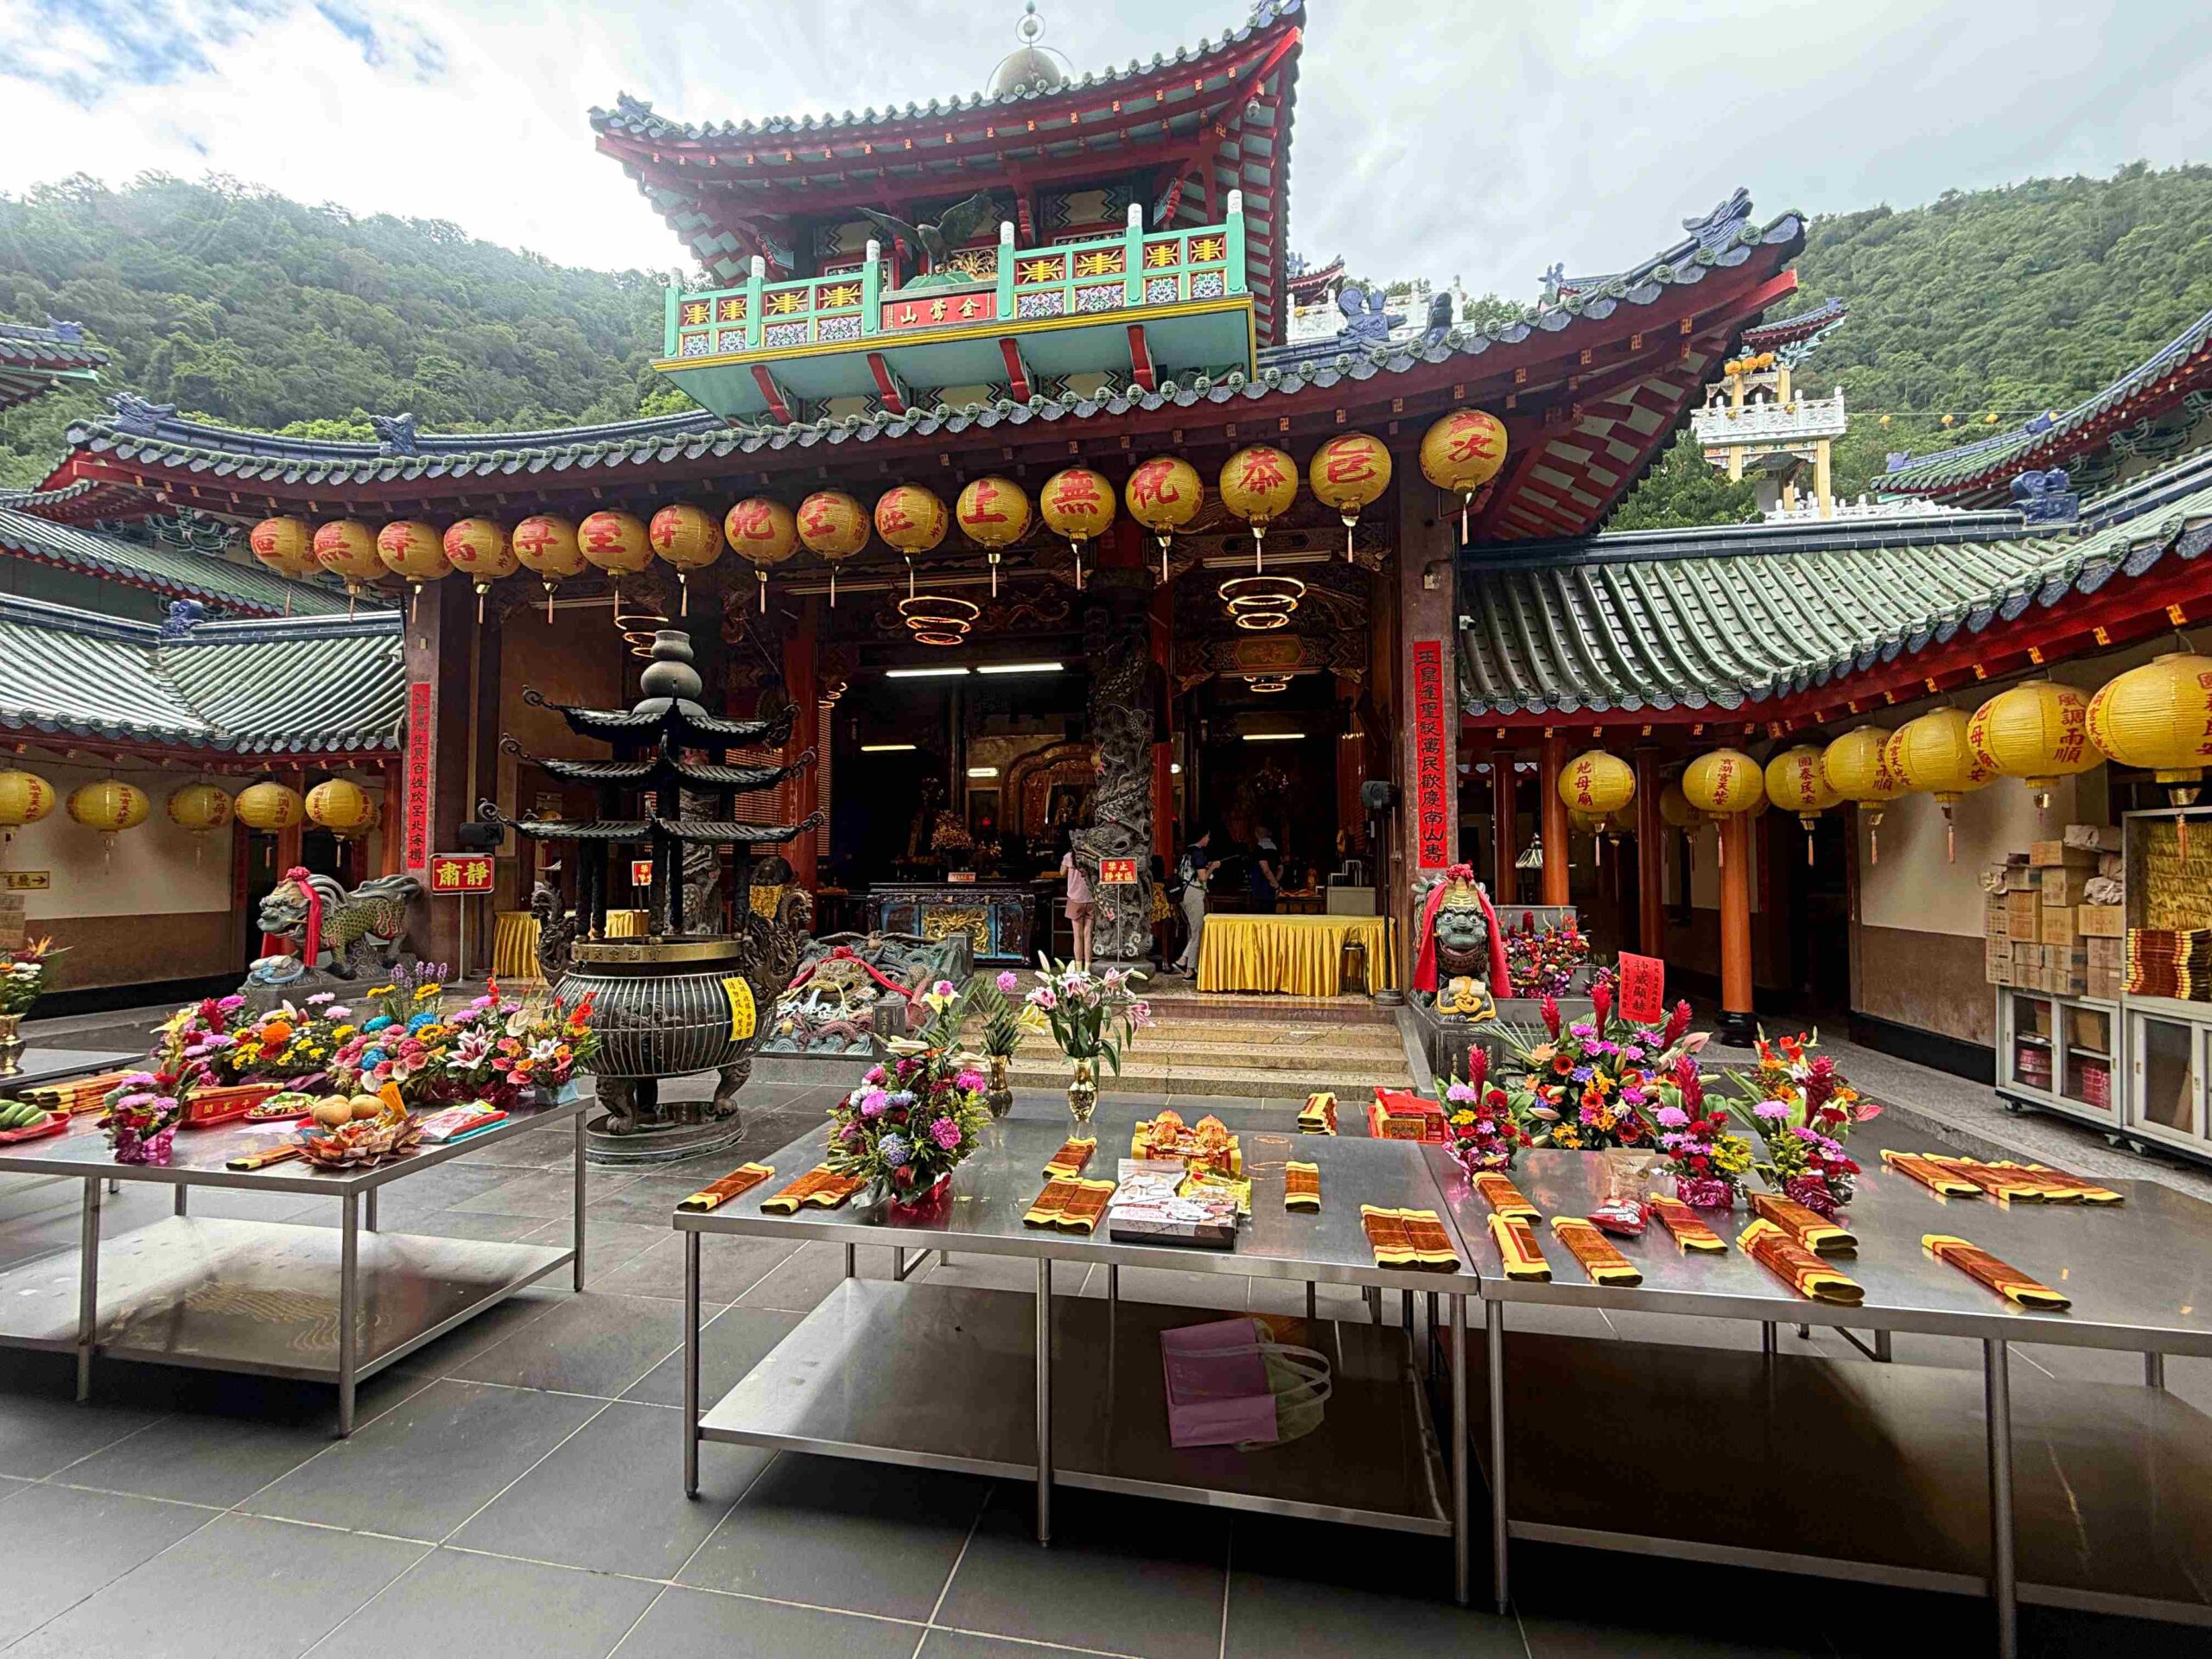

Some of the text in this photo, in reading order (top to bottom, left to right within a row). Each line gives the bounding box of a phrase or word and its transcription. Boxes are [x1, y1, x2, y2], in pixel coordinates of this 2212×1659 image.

[1052, 471, 1102, 515] 無
[1130, 461, 1179, 508] 祝
[1239, 448, 1287, 496] 恭
[731, 500, 775, 540] 地
[962, 482, 1005, 525] 上
[515, 520, 557, 556] 尊
[583, 514, 622, 553] 至
[2053, 693, 2086, 763] 風調雨順
[1574, 760, 1593, 805] 地母廟
[1798, 756, 1816, 805] 國泰民安
[436, 861, 490, 887] 肅靜
